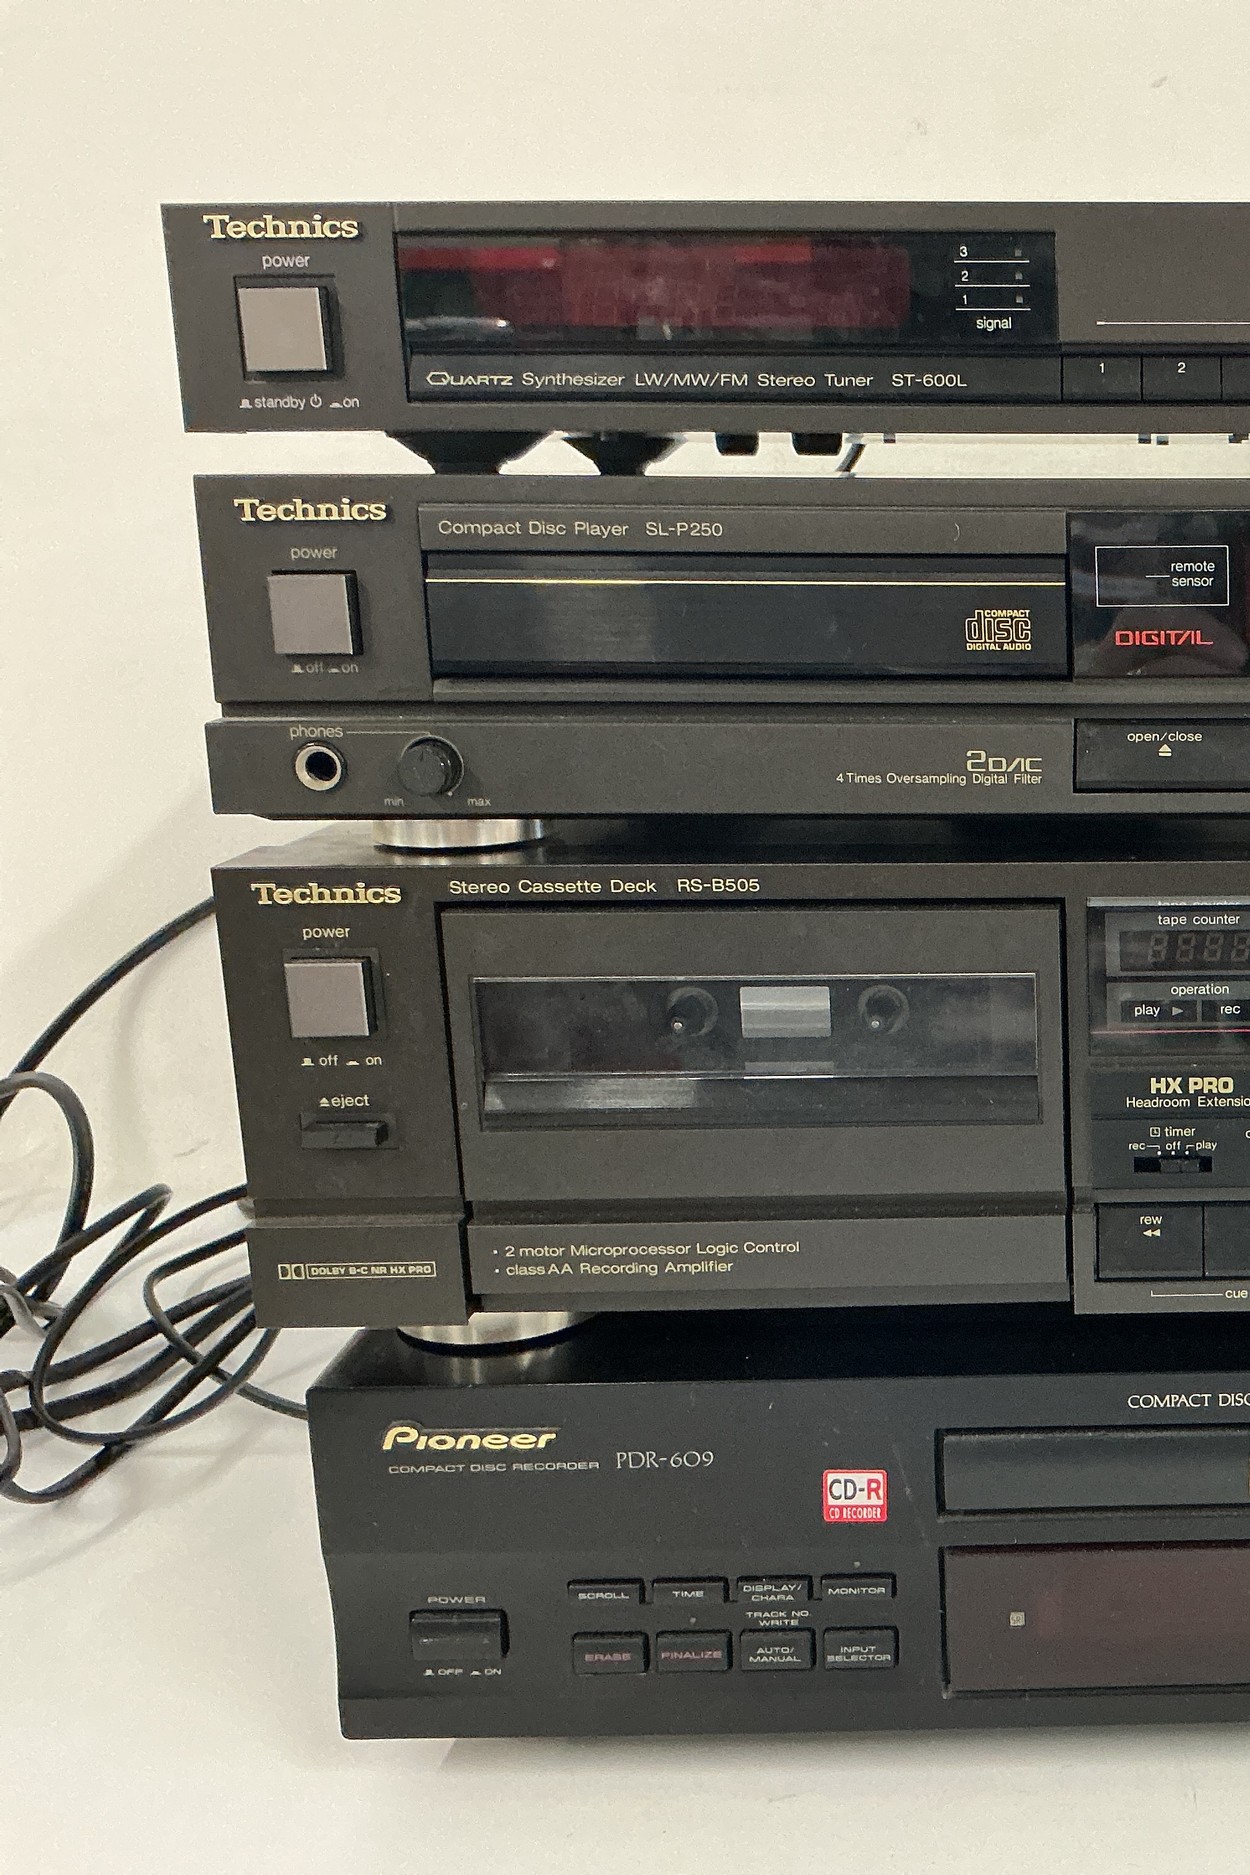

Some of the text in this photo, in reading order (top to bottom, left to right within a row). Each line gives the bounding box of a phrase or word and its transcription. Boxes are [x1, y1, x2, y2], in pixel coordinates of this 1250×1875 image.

[202, 214, 359, 239] Technics
[261, 253, 311, 272] power
[976, 315, 1012, 332] signal
[521, 371, 626, 389] Synthesizer
[635, 372, 748, 388] LW/MW/FM
[757, 373, 816, 387] Stereo
[824, 373, 874, 387] Tuner
[891, 373, 968, 387] ST-600L
[253, 395, 306, 411] standby
[233, 497, 387, 522] Technics
[438, 520, 723, 539] Compact Disc Player SL-P250
[290, 544, 338, 561] power
[1170, 560, 1216, 572] remote
[1171, 575, 1214, 587] sensor
[1115, 630, 1214, 646] DIGITAL
[289, 723, 344, 741] phones
[1127, 730, 1203, 743] open/close
[836, 772, 1043, 787] 4 Times Oversampling Digital Filter
[250, 882, 402, 905] Technics
[449, 878, 760, 895] Stereo Cassette Deck RS-B505
[1157, 913, 1241, 927] tape counter
[302, 925, 350, 941] power
[1170, 983, 1230, 997] operation
[1134, 1003, 1161, 1018] play
[1220, 1003, 1241, 1015] rec
[1150, 1076, 1234, 1095] HX PRO
[330, 1094, 370, 1109] eject
[1126, 1096, 1191, 1108] Headroom
[1164, 1126, 1196, 1137] timer
[1139, 1215, 1163, 1225] rew
[505, 1241, 800, 1258] 2 motor Microprocessor Logic Control
[579, 1262, 658, 1278] Recording
[664, 1260, 734, 1277] Amplifier
[1224, 1289, 1248, 1299] cue
[1127, 1393, 1212, 1409] COMPACT
[616, 1450, 714, 1469] PDR-609
[388, 1461, 600, 1474] COMPACT DISC RECORDER
[827, 1477, 883, 1501] CD-R
[578, 1592, 630, 1600] SCROLL
[672, 1590, 704, 1598] TIME
[827, 1587, 886, 1595] MONITOR
[427, 1596, 486, 1604] POWER
[756, 1646, 795, 1655] AUTO/
[840, 1645, 877, 1654] INPUT
[749, 1654, 802, 1663] MANUAL
[826, 1653, 891, 1662] SELECTOR
